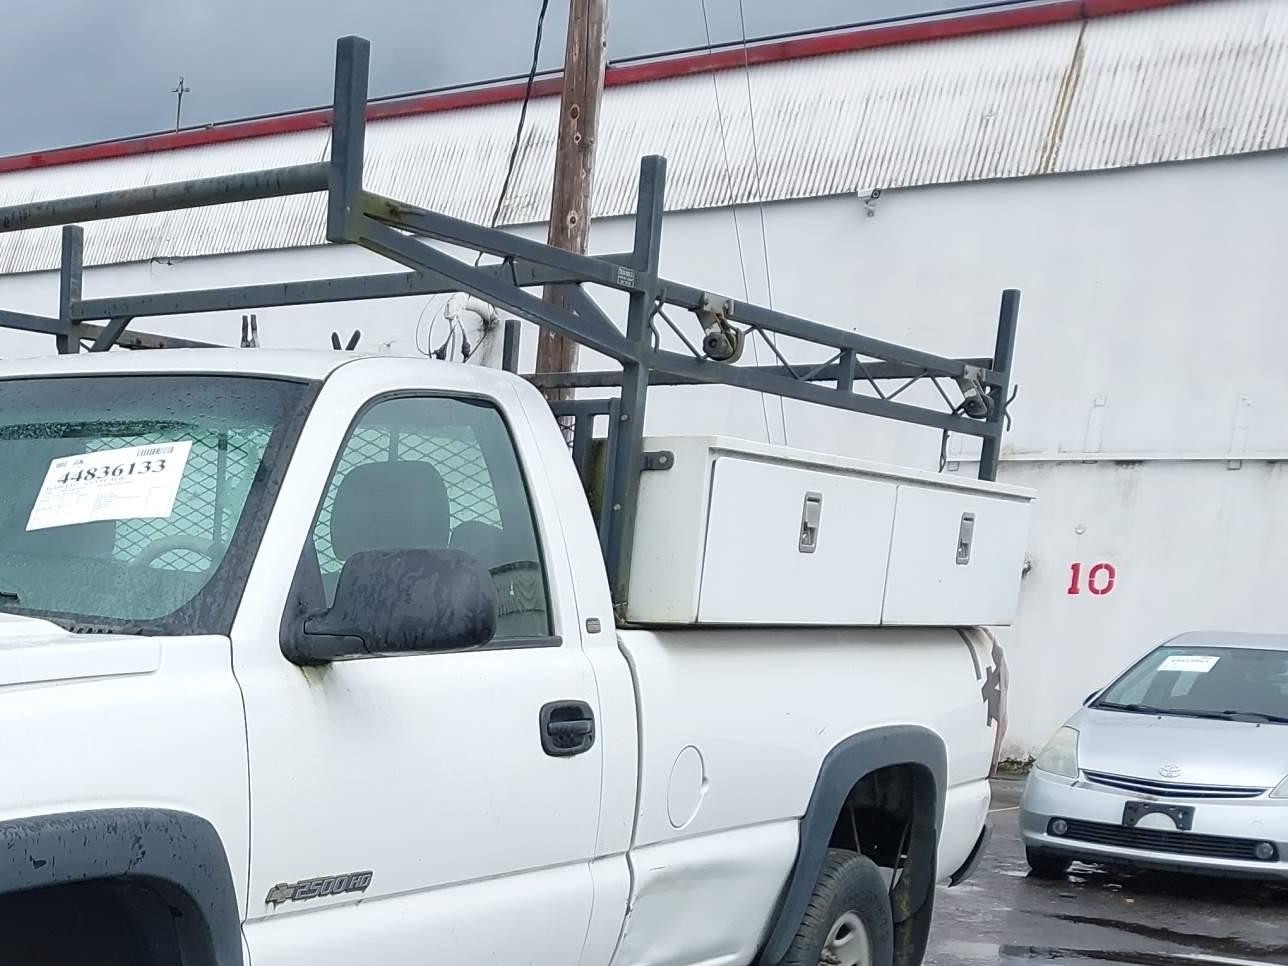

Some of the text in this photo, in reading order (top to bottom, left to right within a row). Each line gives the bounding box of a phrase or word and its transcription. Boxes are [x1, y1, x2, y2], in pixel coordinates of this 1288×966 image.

[57, 458, 167, 485] 44836133
[1067, 562, 1117, 595] 10
[295, 873, 372, 899] 2500 HD
